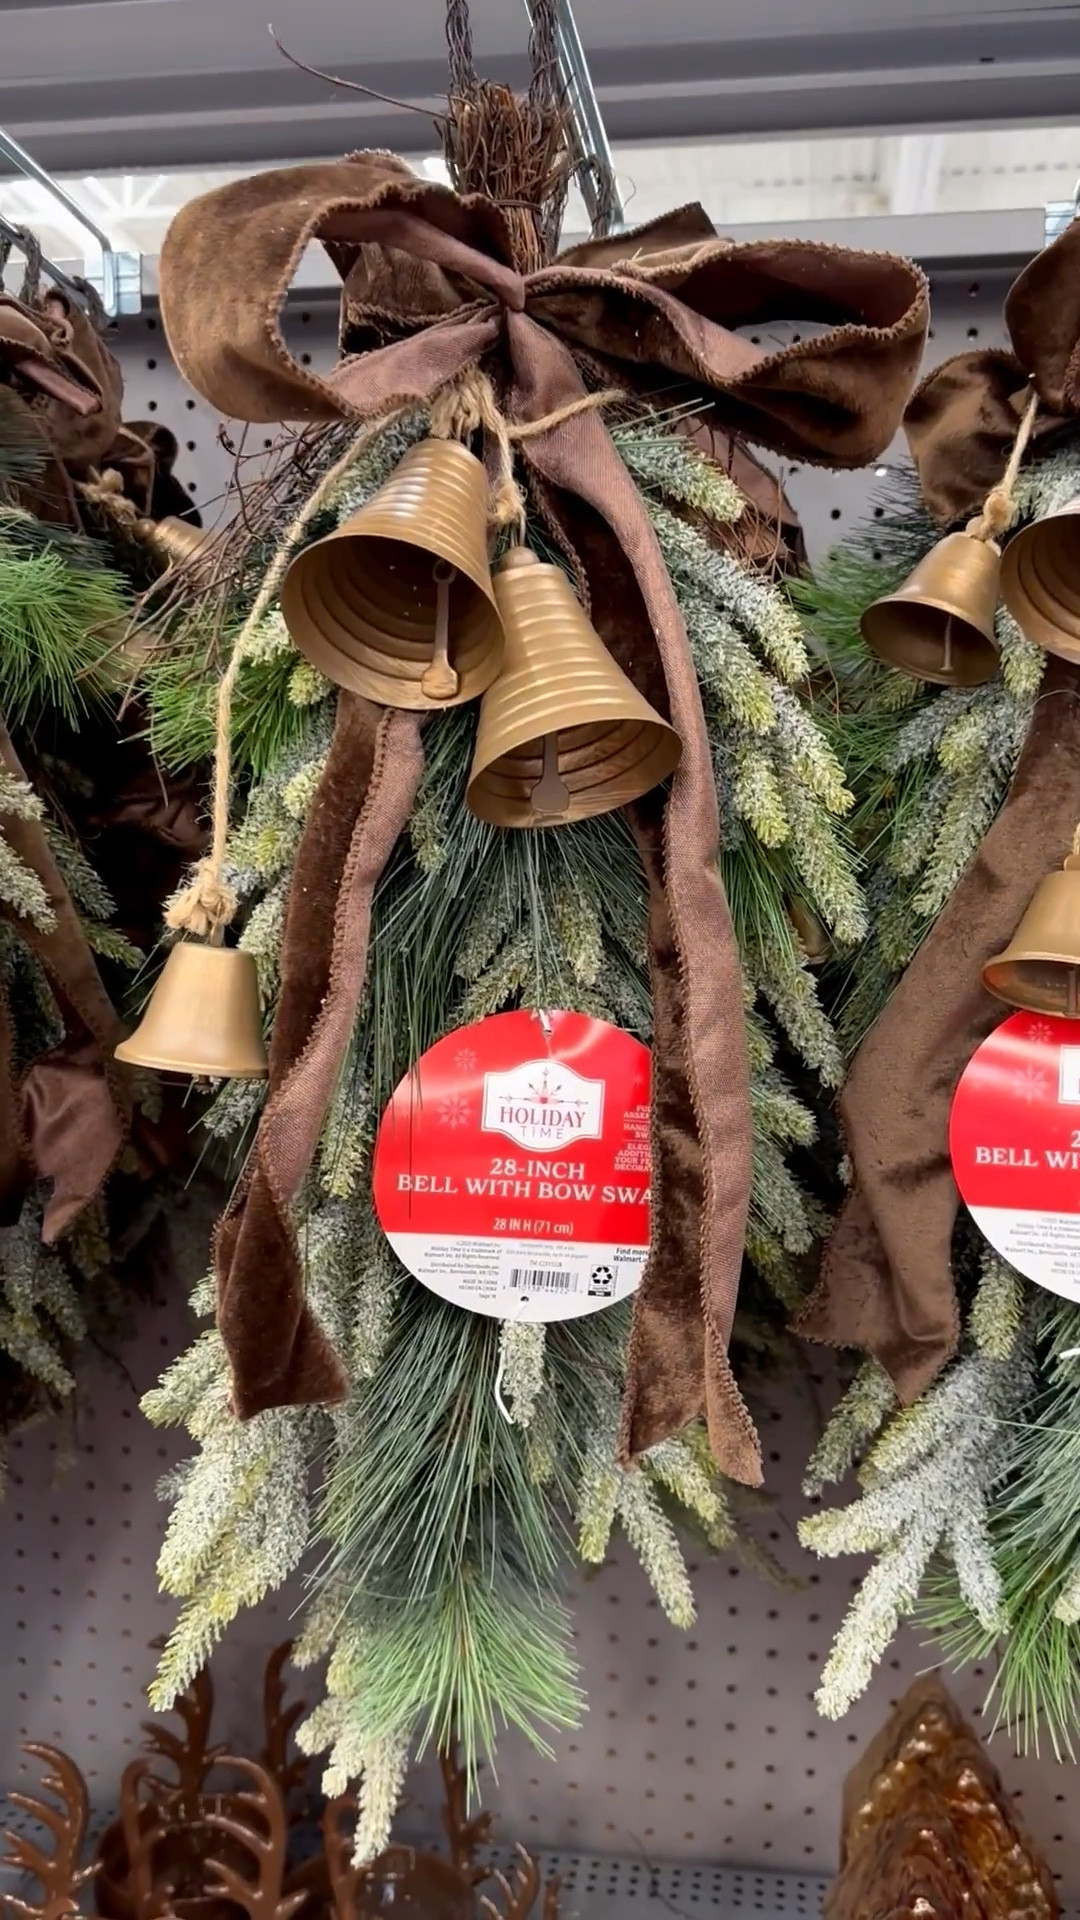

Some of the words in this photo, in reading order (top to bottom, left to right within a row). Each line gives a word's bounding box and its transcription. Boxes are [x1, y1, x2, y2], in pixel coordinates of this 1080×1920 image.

[500, 1106, 586, 1128] HOLIDAY
[521, 1126, 564, 1139] TIME
[490, 1158, 585, 1180] 28-INCH
[976, 1147, 1038, 1167] BELL
[1045, 1150, 1080, 1169] WI
[397, 1174, 458, 1193] BELL
[465, 1178, 531, 1198] WITH
[538, 1182, 595, 1201] BOW
[493, 1218, 507, 1231] 28
[509, 1218, 521, 1231] IN
[523, 1219, 531, 1232] H
[534, 1220, 550, 1233] (71
[553, 1222, 574, 1235] cm)
